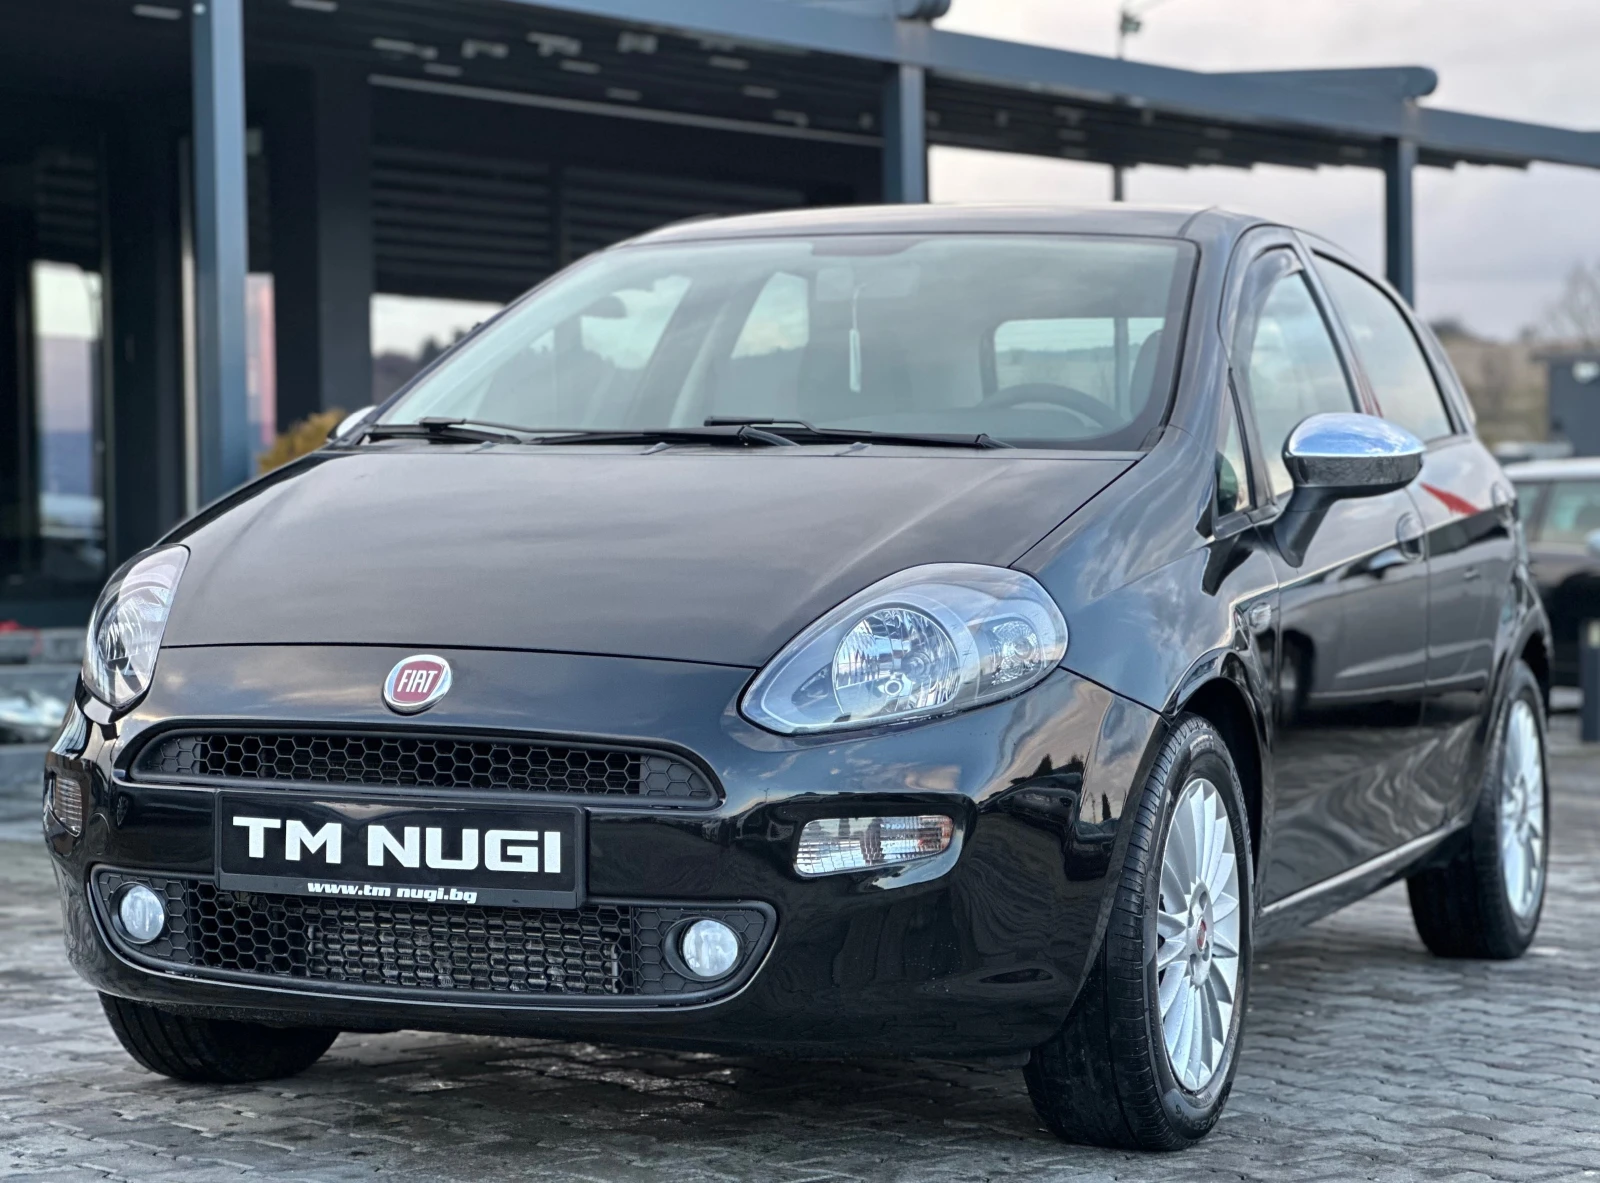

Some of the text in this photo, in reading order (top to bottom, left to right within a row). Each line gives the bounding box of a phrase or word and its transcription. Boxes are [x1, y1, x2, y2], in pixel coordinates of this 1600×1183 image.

[396, 669, 438, 694] FIAT
[232, 816, 562, 874] TM NUGI
[307, 882, 478, 904] www.tm nugi.bg
